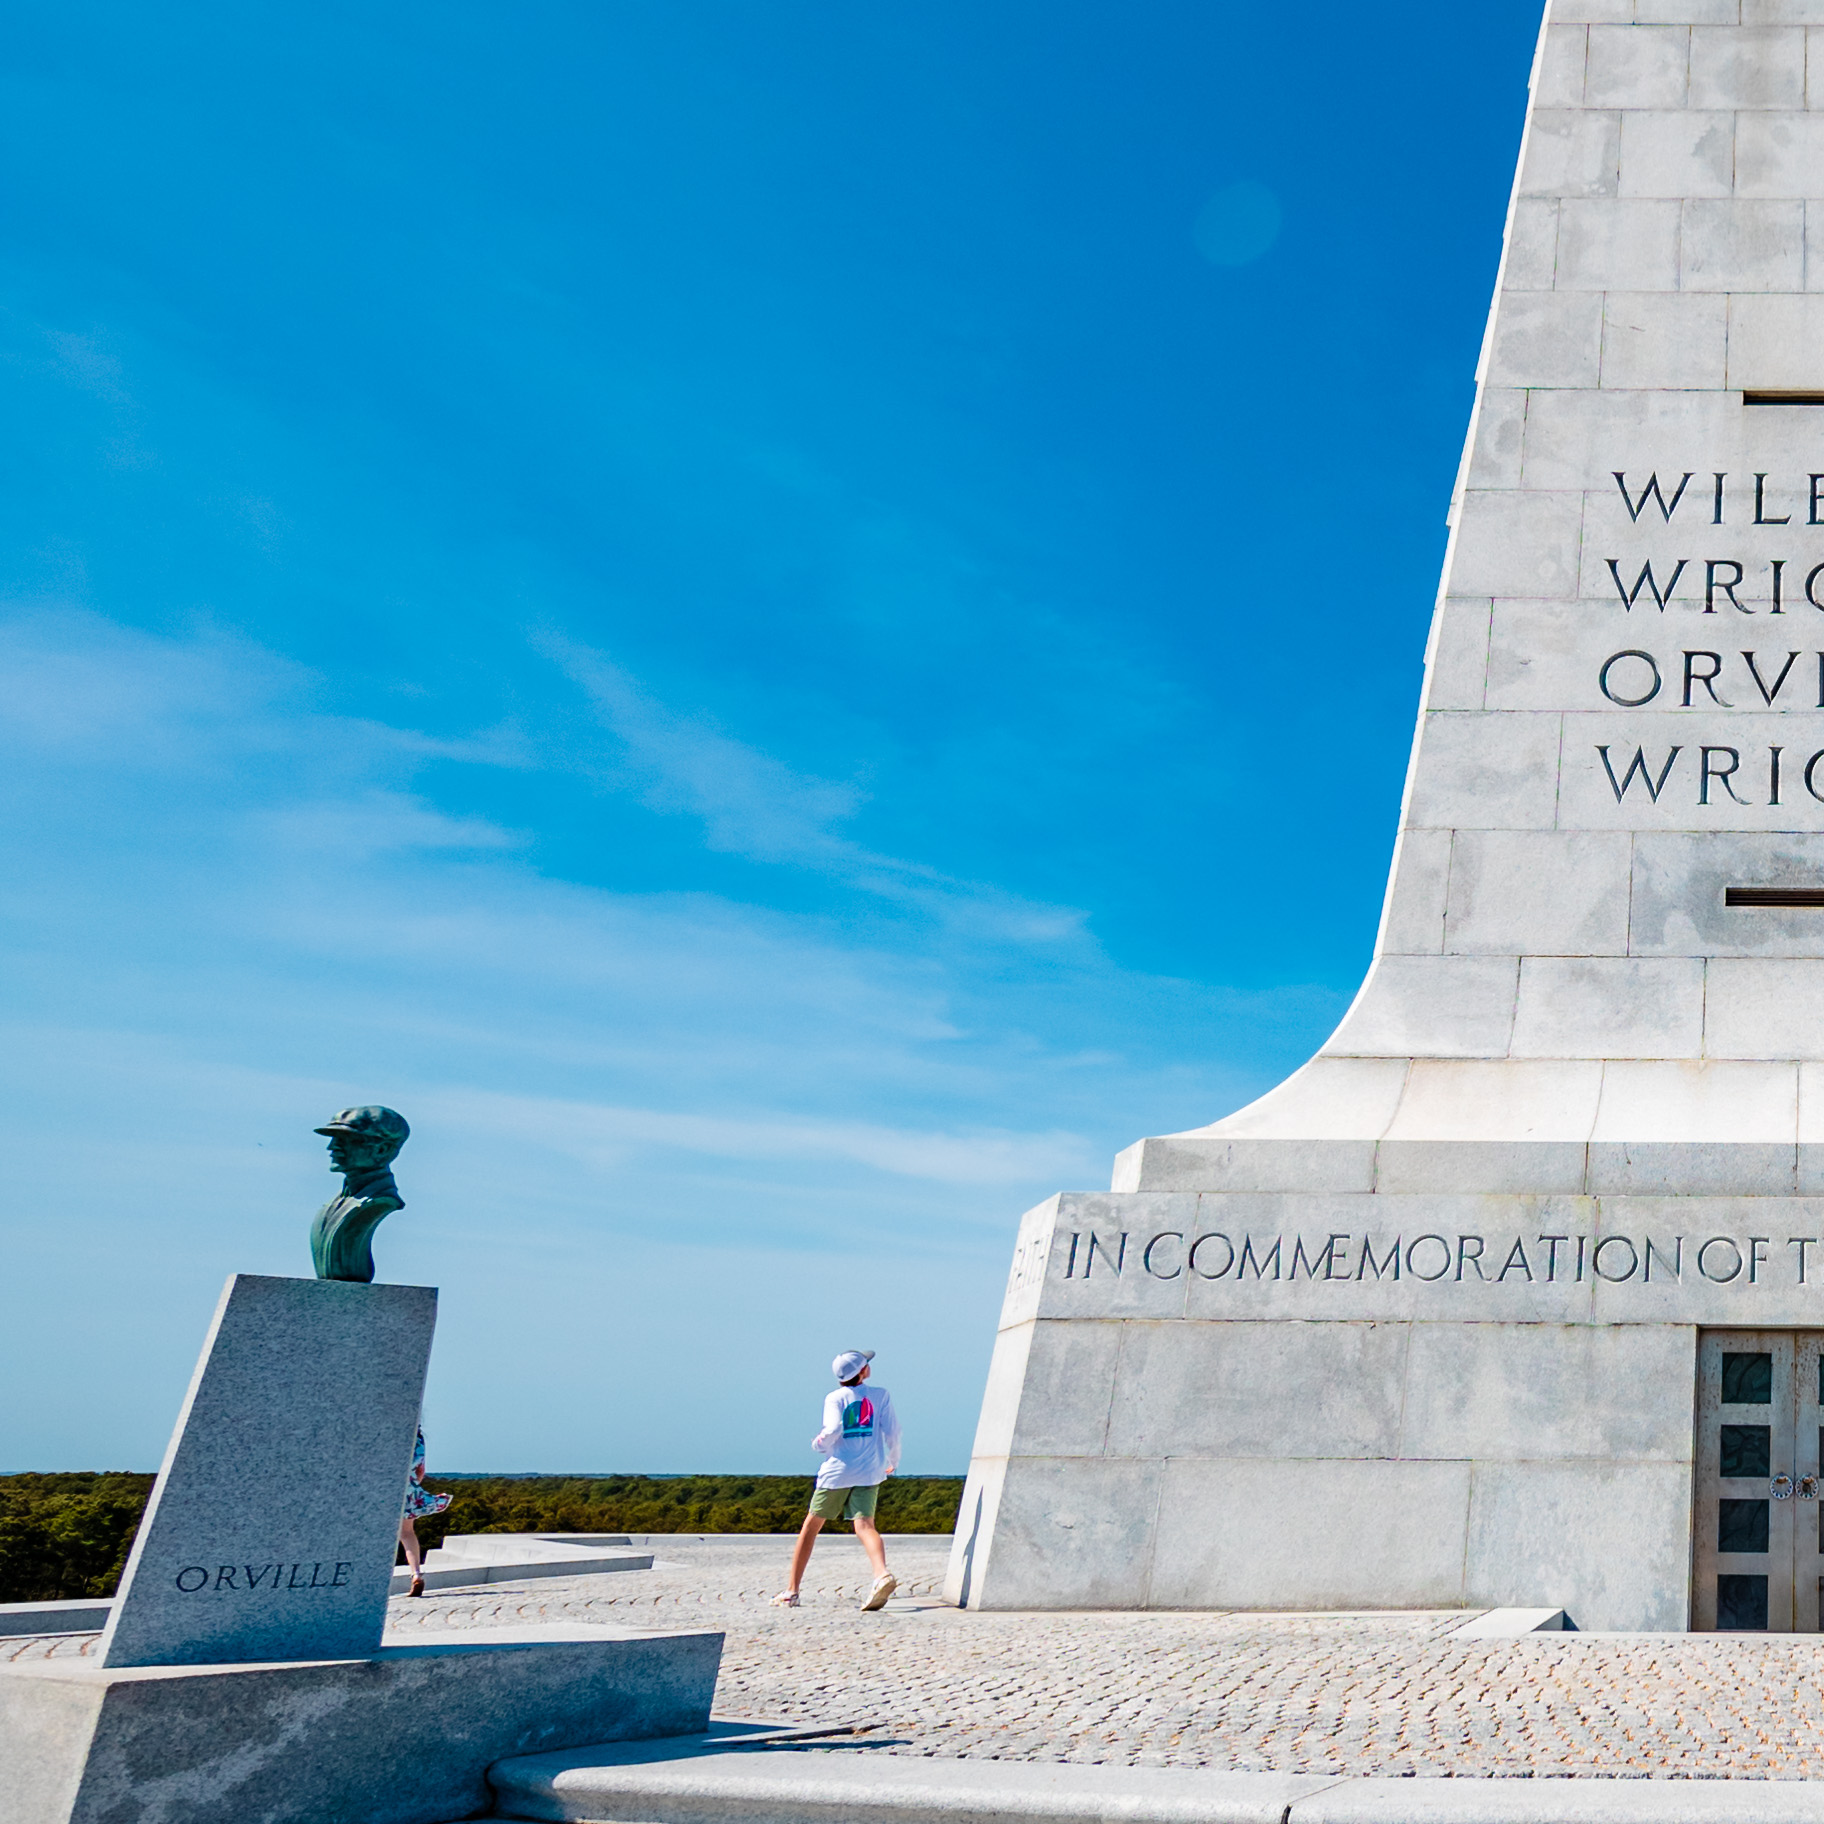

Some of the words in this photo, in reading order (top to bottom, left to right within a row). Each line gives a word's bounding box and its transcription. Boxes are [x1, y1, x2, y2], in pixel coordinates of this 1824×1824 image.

[1064, 1230, 1130, 1280] IN
[1143, 1231, 1684, 1285] COMMEMORATION
[1698, 1235, 1770, 1284] OF
[176, 1561, 354, 1593] ORVILLE
